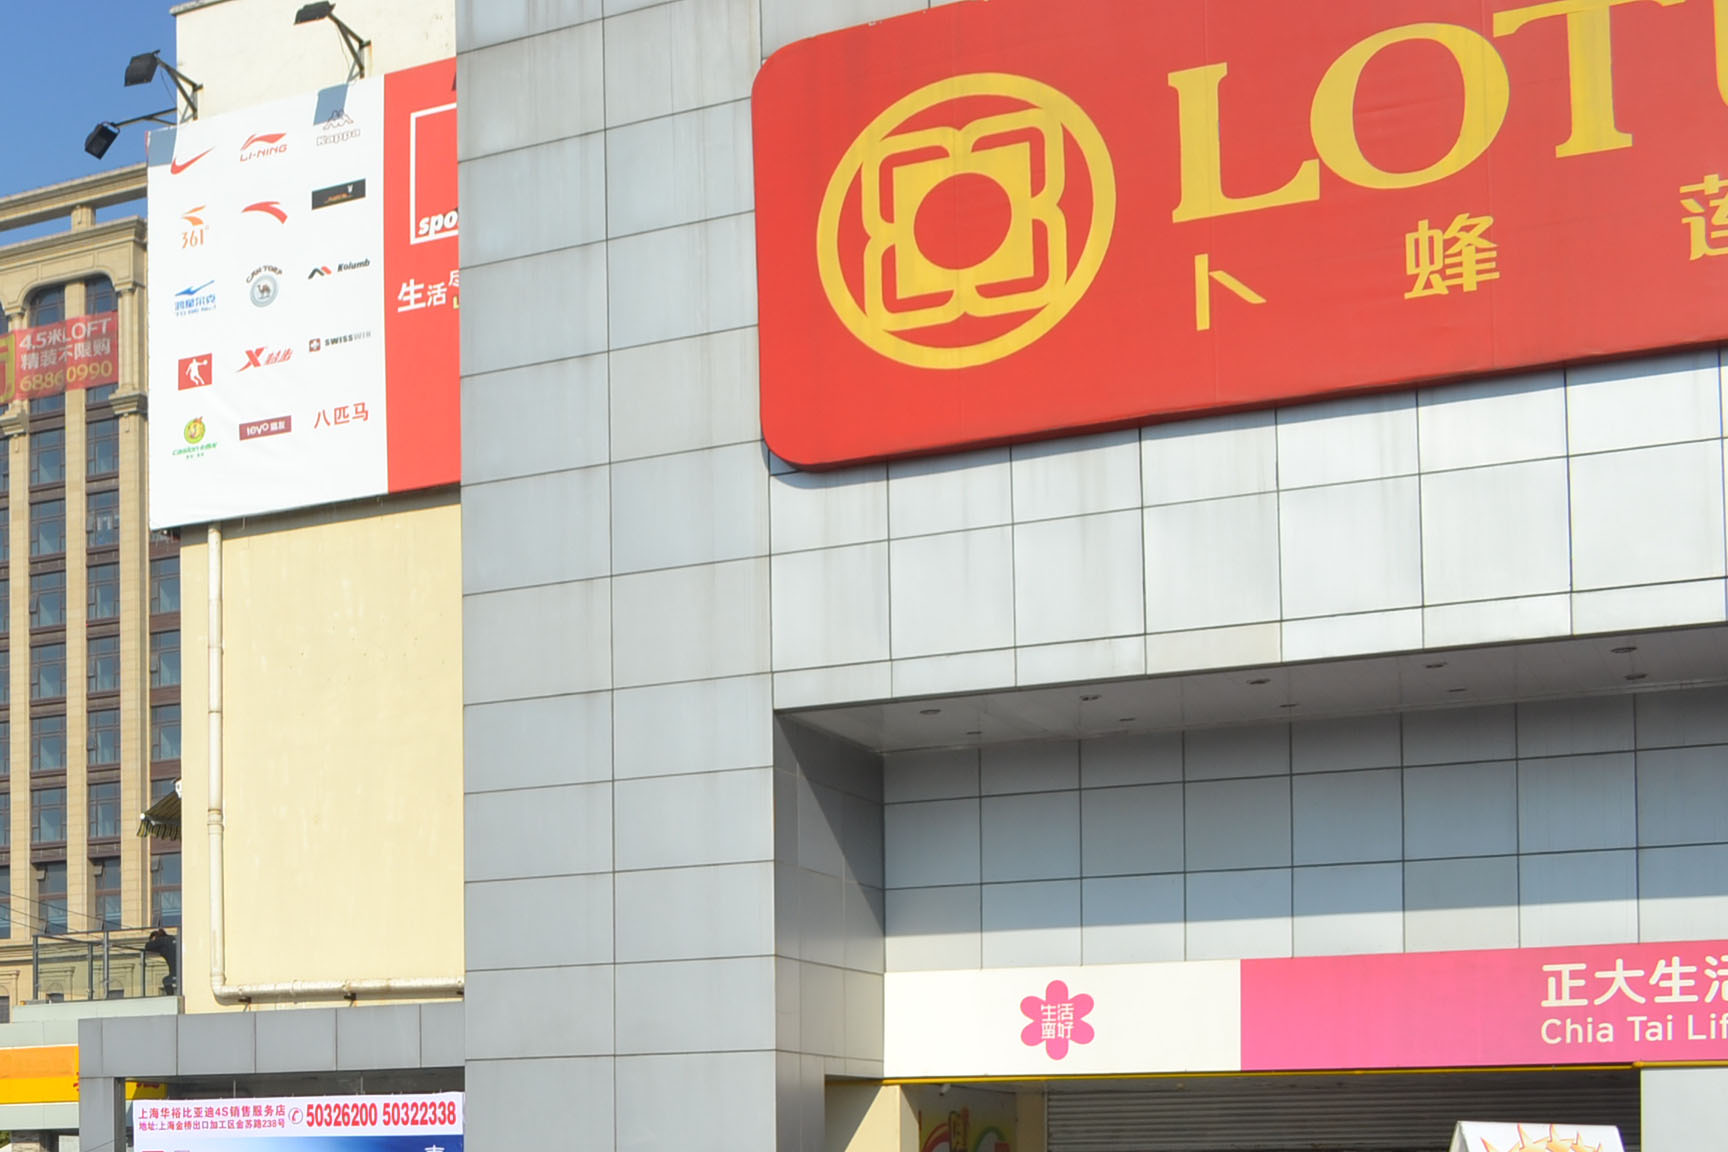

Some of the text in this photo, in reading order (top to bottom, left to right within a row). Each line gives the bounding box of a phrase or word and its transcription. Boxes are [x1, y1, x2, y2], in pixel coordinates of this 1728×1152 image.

[1168, 0, 1728, 223] LOT
[240, 144, 288, 163] LI-NING
[337, 258, 371, 273] Kolumb
[20, 360, 113, 392] 68860990
[314, 402, 369, 429] 八匹马
[1541, 1017, 1614, 1044] Chia
[1626, 1014, 1673, 1042] Tai
[306, 1100, 456, 1128] 50326200 50322338
